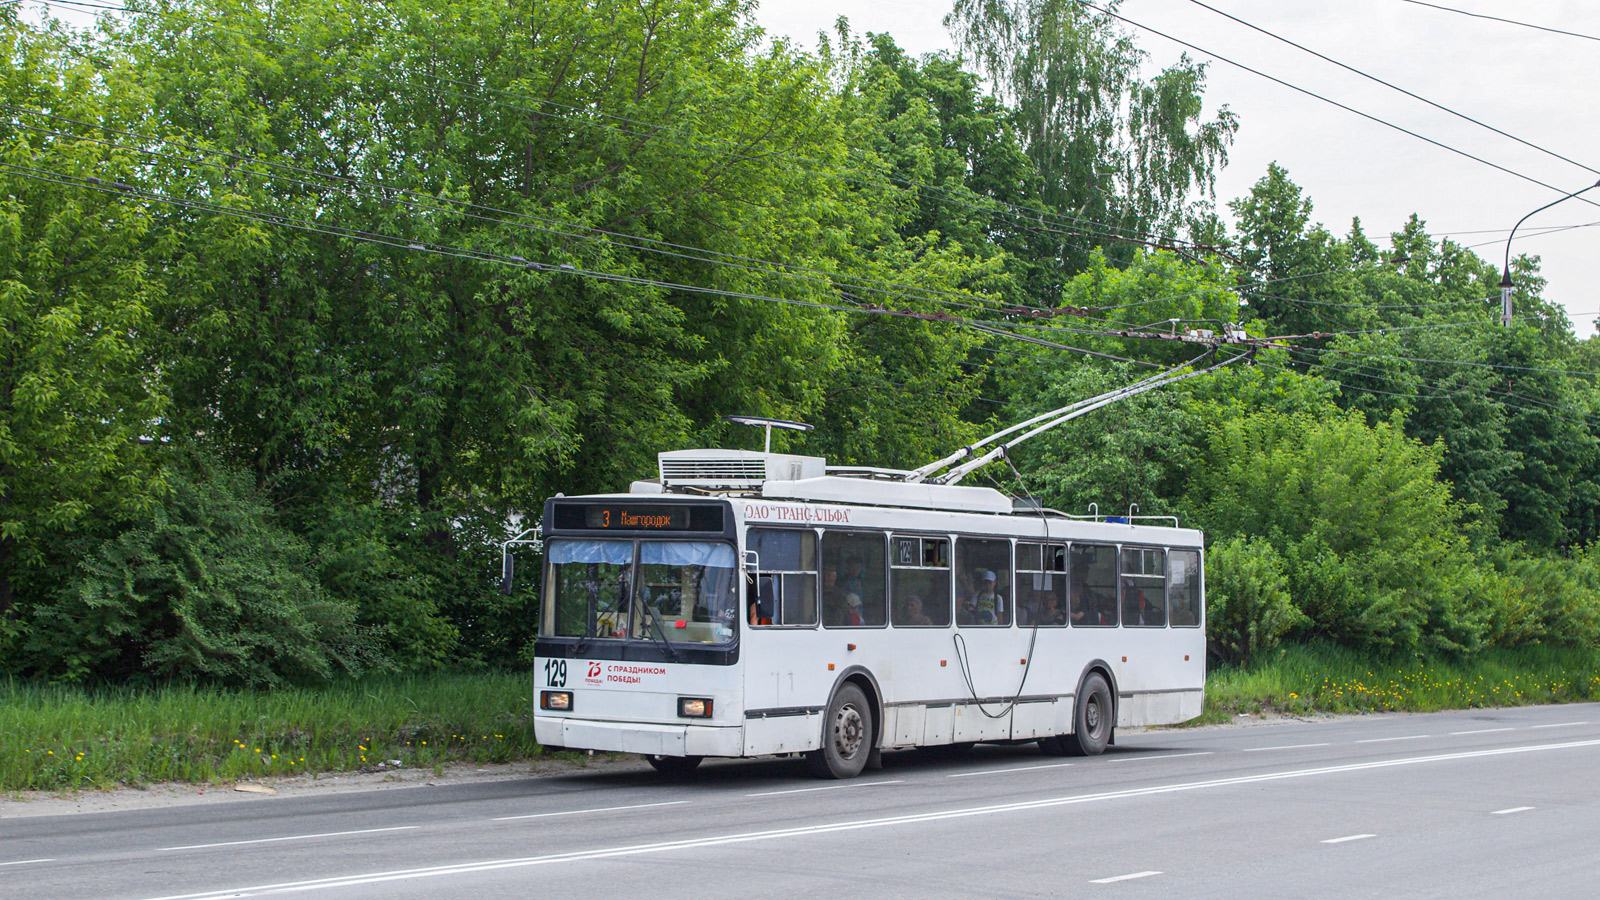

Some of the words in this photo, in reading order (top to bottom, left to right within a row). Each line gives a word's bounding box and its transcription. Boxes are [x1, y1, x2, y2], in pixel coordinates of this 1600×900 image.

[602, 510, 610, 528] 3
[621, 510, 671, 528] Машгородок
[544, 658, 567, 688] 129
[587, 661, 602, 678] 75
[613, 665, 666, 675] ПРАЗДНИКОМ
[607, 674, 641, 684] ПОБЕДЫ!
